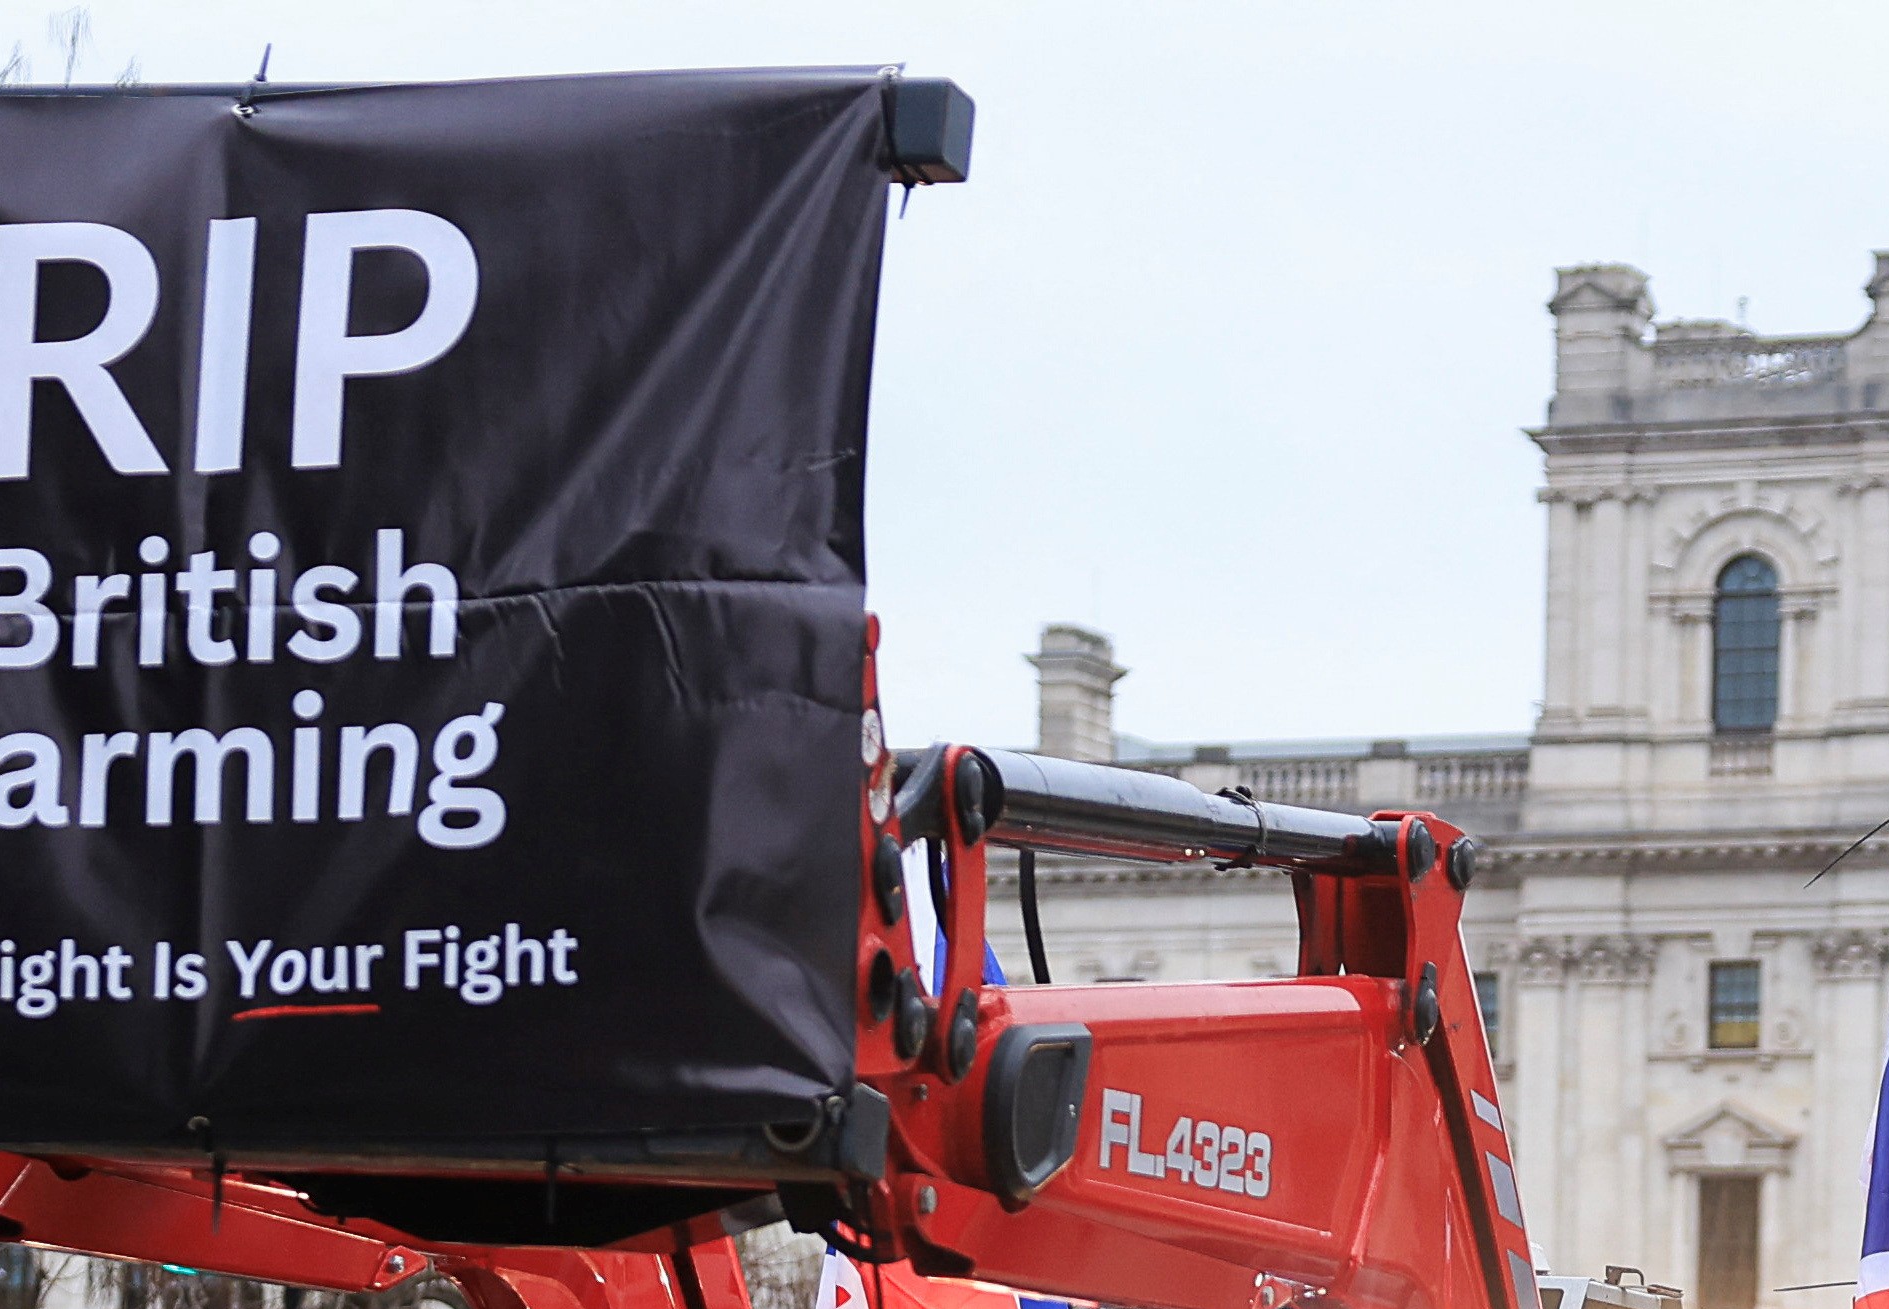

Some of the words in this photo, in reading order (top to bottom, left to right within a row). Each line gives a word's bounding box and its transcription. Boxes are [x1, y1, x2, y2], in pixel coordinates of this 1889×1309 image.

[155, 942, 206, 998] Is
[227, 940, 382, 997] Your
[406, 923, 577, 1002] Fight
[1099, 1088, 1271, 1199] FL.4323
